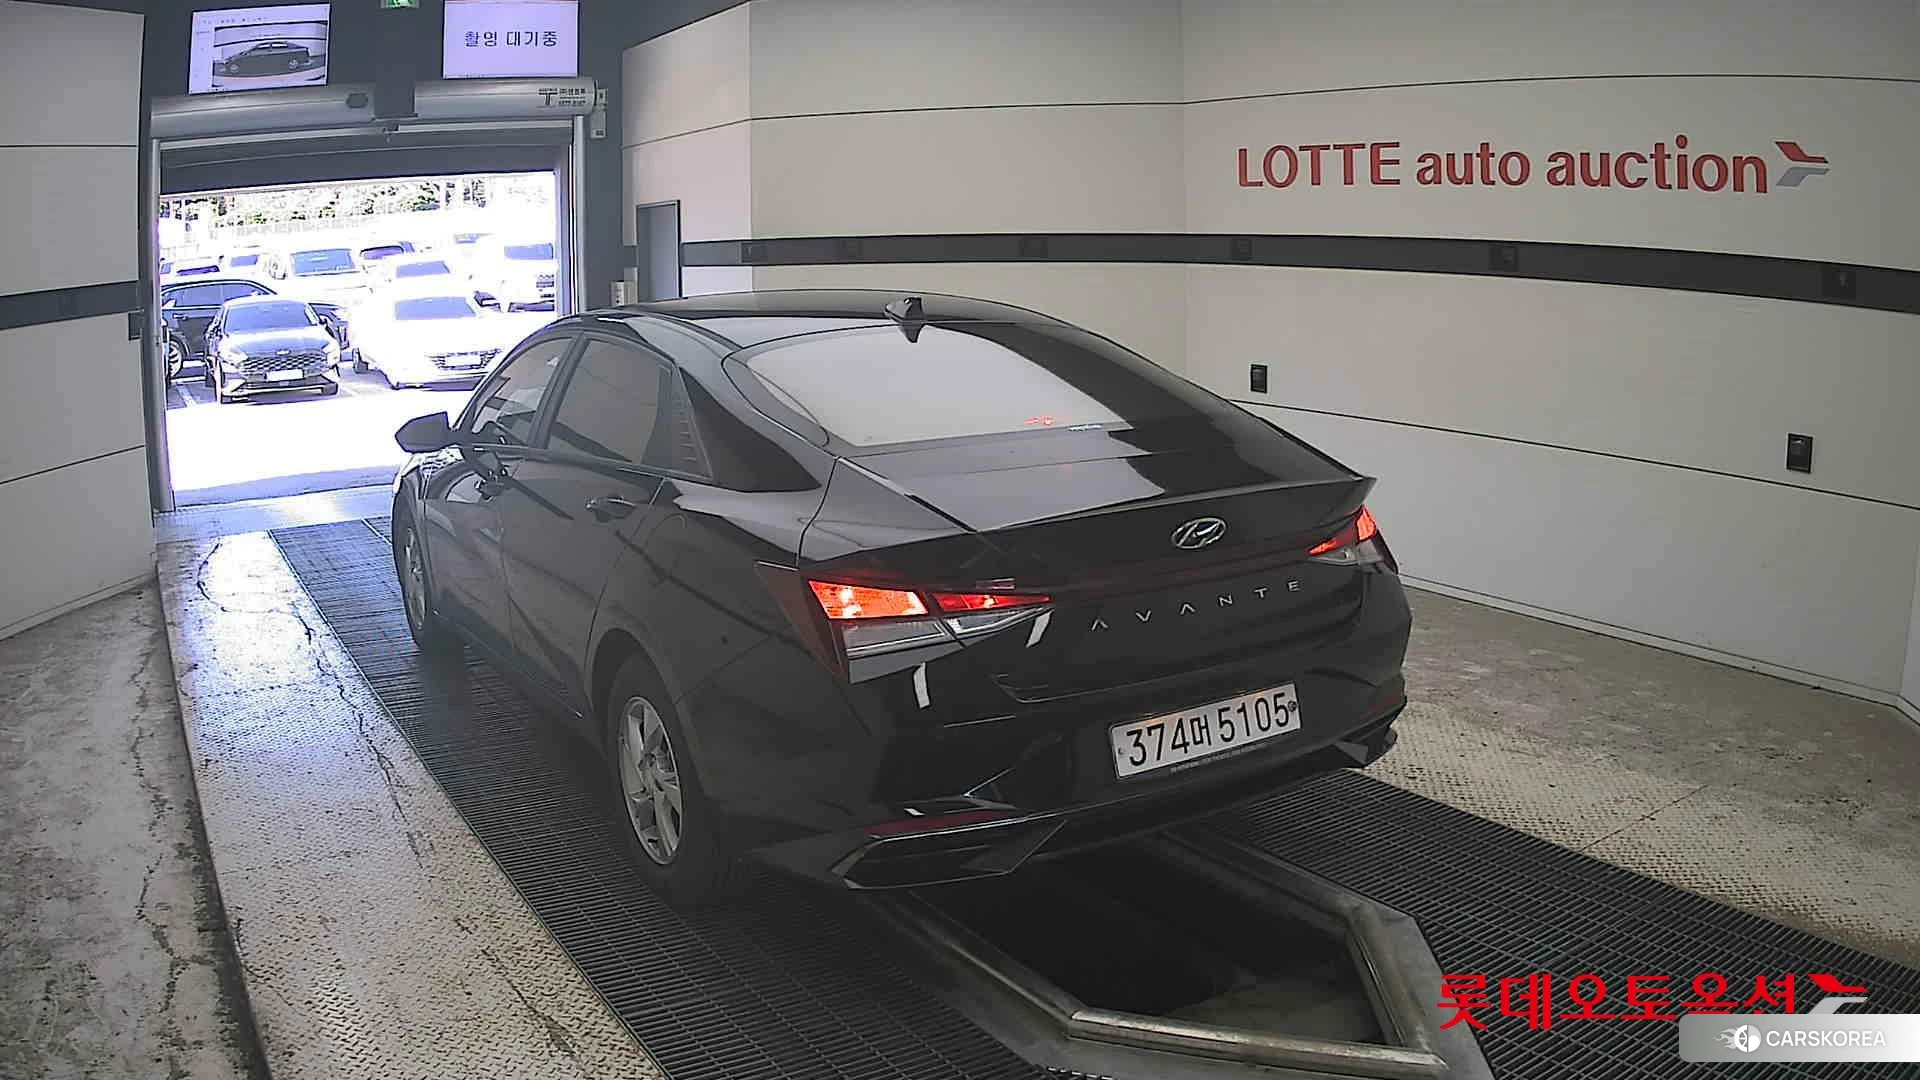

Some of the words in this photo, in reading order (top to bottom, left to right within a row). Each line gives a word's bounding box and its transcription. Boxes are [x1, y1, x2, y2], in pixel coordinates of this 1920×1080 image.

[506, 31, 558, 47] 대기중
[1237, 141, 1401, 188] LOTTE
[1416, 141, 1531, 186] auto
[1546, 134, 1769, 194] auction
[1090, 579, 1301, 632] AVANTE
